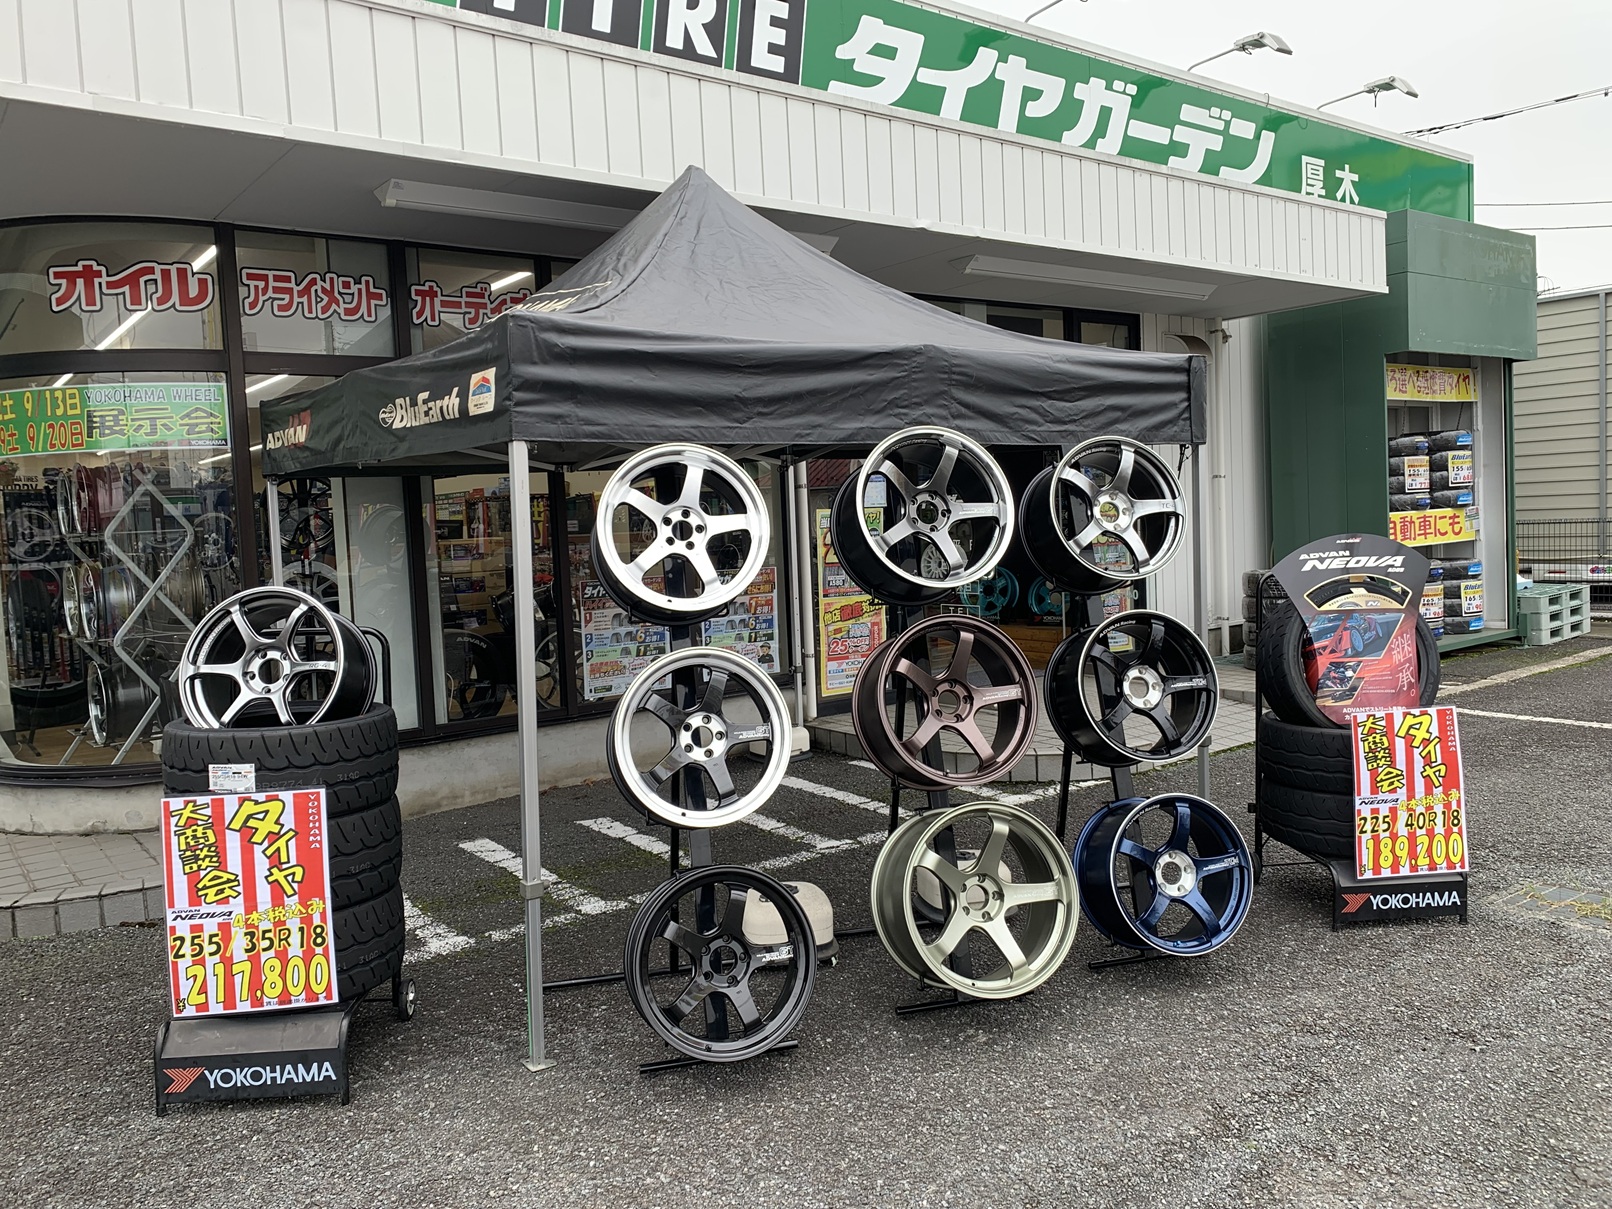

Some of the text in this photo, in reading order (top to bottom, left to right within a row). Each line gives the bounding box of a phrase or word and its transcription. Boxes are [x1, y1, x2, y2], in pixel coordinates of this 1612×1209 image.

[493, 0, 788, 73] RE
[829, 14, 1360, 205] タイヤガーデン 厚木
[47, 258, 213, 313] オイル
[240, 267, 389, 322] アライメント
[84, 387, 222, 404] YOKOHAMA WHEEL
[392, 387, 460, 430] BluEarth
[85, 406, 224, 441] 展示会
[266, 424, 308, 451] ADVAN
[1070, 449, 1092, 463] ADVAN
[1298, 550, 1350, 561] ADVAN
[1300, 556, 1406, 572] NEOVA
[456, 636, 487, 648] ADVAN
[1099, 622, 1120, 638] ADVAN
[828, 639, 849, 655] 25
[1445, 709, 1456, 752] YOKOHAMA
[1358, 715, 1405, 794] 大商談会
[1396, 713, 1447, 788] タイヤ
[1359, 797, 1400, 806] NEOVA
[1398, 789, 1460, 812] 4本税込み
[308, 793, 322, 849] YOKOHAMA
[170, 799, 242, 905] 大商談会
[226, 798, 305, 899] タイヤ
[232, 899, 325, 929] 4本税込み
[1369, 891, 1461, 910] YOKOHAMA
[170, 910, 234, 922] NEOVA
[203, 1061, 337, 1089] YOKOHAMA
